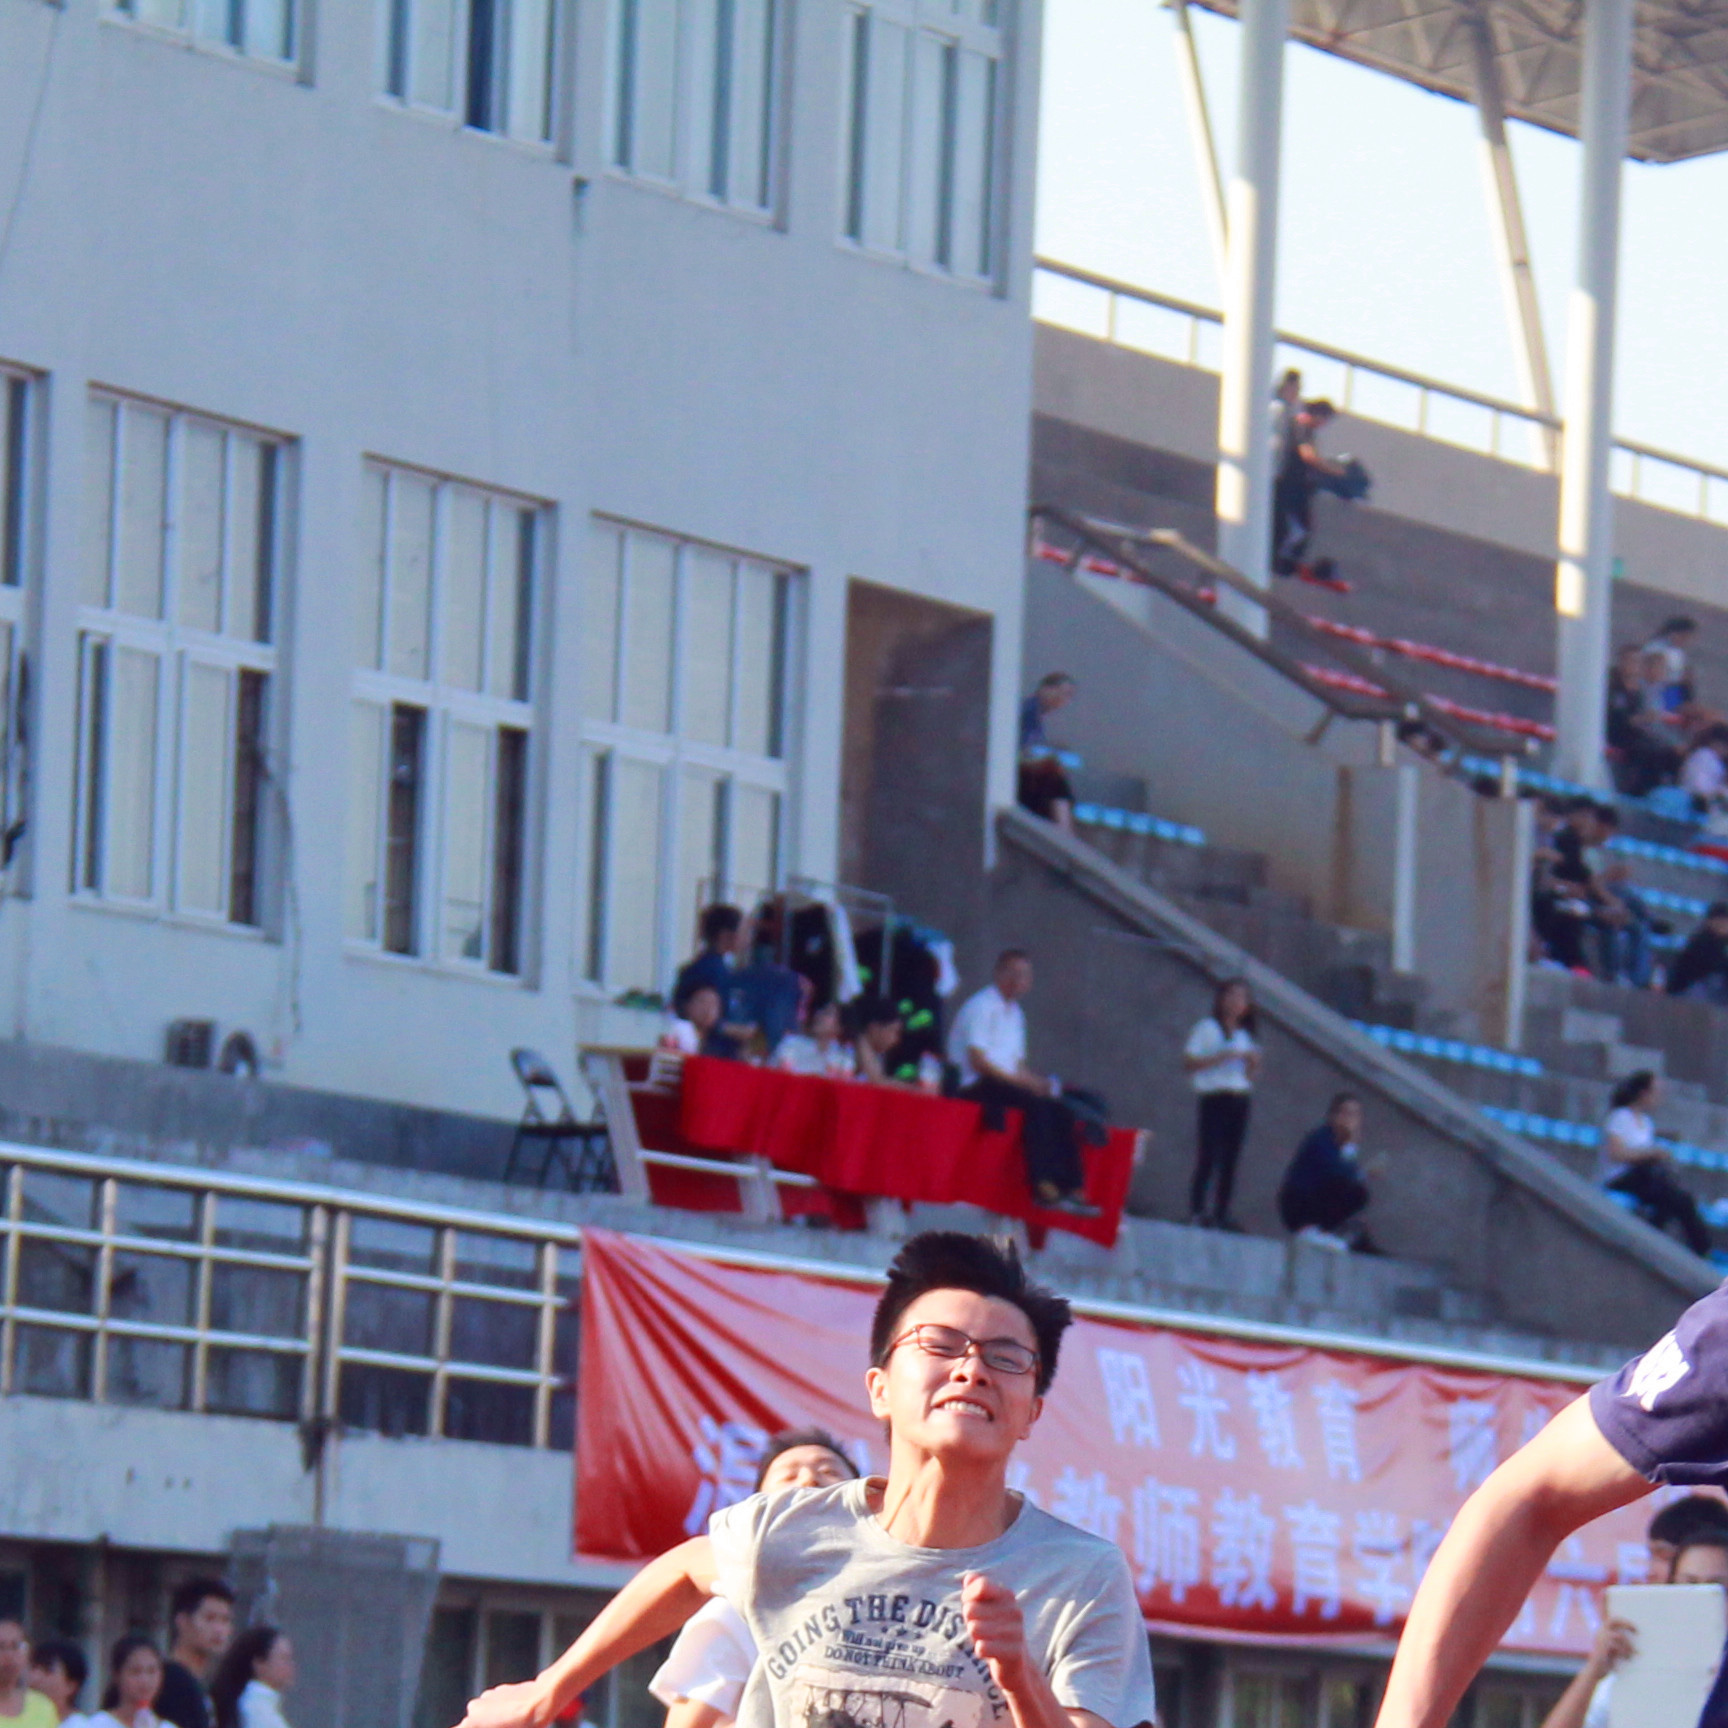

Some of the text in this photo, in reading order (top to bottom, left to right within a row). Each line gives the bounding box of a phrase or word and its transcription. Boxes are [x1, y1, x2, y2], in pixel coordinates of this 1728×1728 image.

[1095, 1347, 1364, 1484] 阳光教育
[766, 1604, 842, 1680] GOING
[844, 1594, 910, 1625] THE
[824, 1646, 965, 1679] DO NOT THINK ABOUT
[911, 1645, 926, 1656] up
